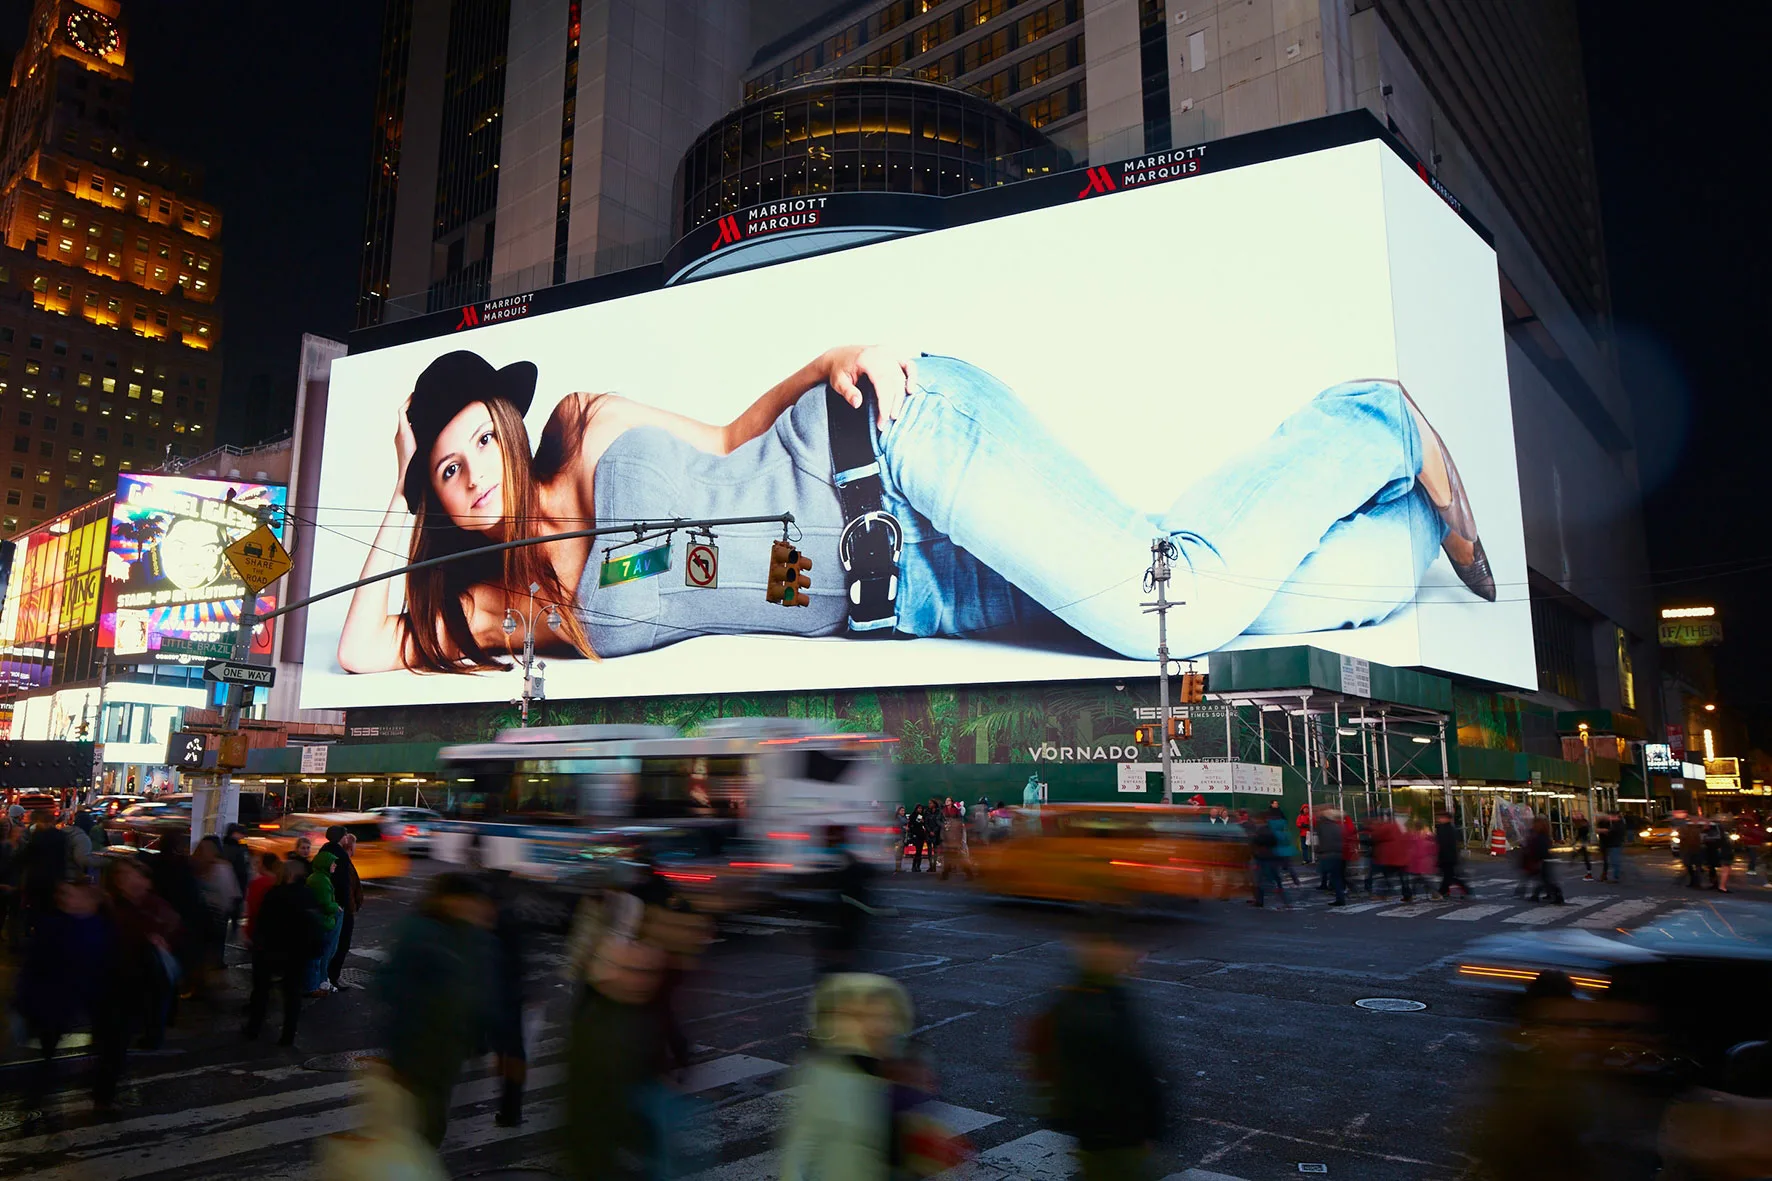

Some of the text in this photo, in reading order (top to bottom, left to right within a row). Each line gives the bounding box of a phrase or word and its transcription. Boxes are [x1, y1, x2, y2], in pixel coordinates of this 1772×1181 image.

[1124, 146, 1206, 172] MARRIOTT
[1124, 162, 1197, 185] MARQUIS
[1431, 176, 1461, 212] MARRIOTT
[748, 198, 827, 220] MARRIOTT
[748, 213, 817, 234] MARQUIS
[484, 293, 534, 311] MARRIOTT
[483, 305, 527, 321] MARQUIS
[245, 557, 273, 569] SHARE
[622, 560, 630, 577] 7
[246, 574, 268, 585] ROAD
[1662, 624, 1720, 639] IF/THEN
[162, 638, 193, 650] LITTLE
[197, 643, 231, 654] BRAZIL
[223, 668, 269, 680] ONE WAY
[350, 727, 379, 737] 1535
[1028, 745, 1139, 762] VORNADO
